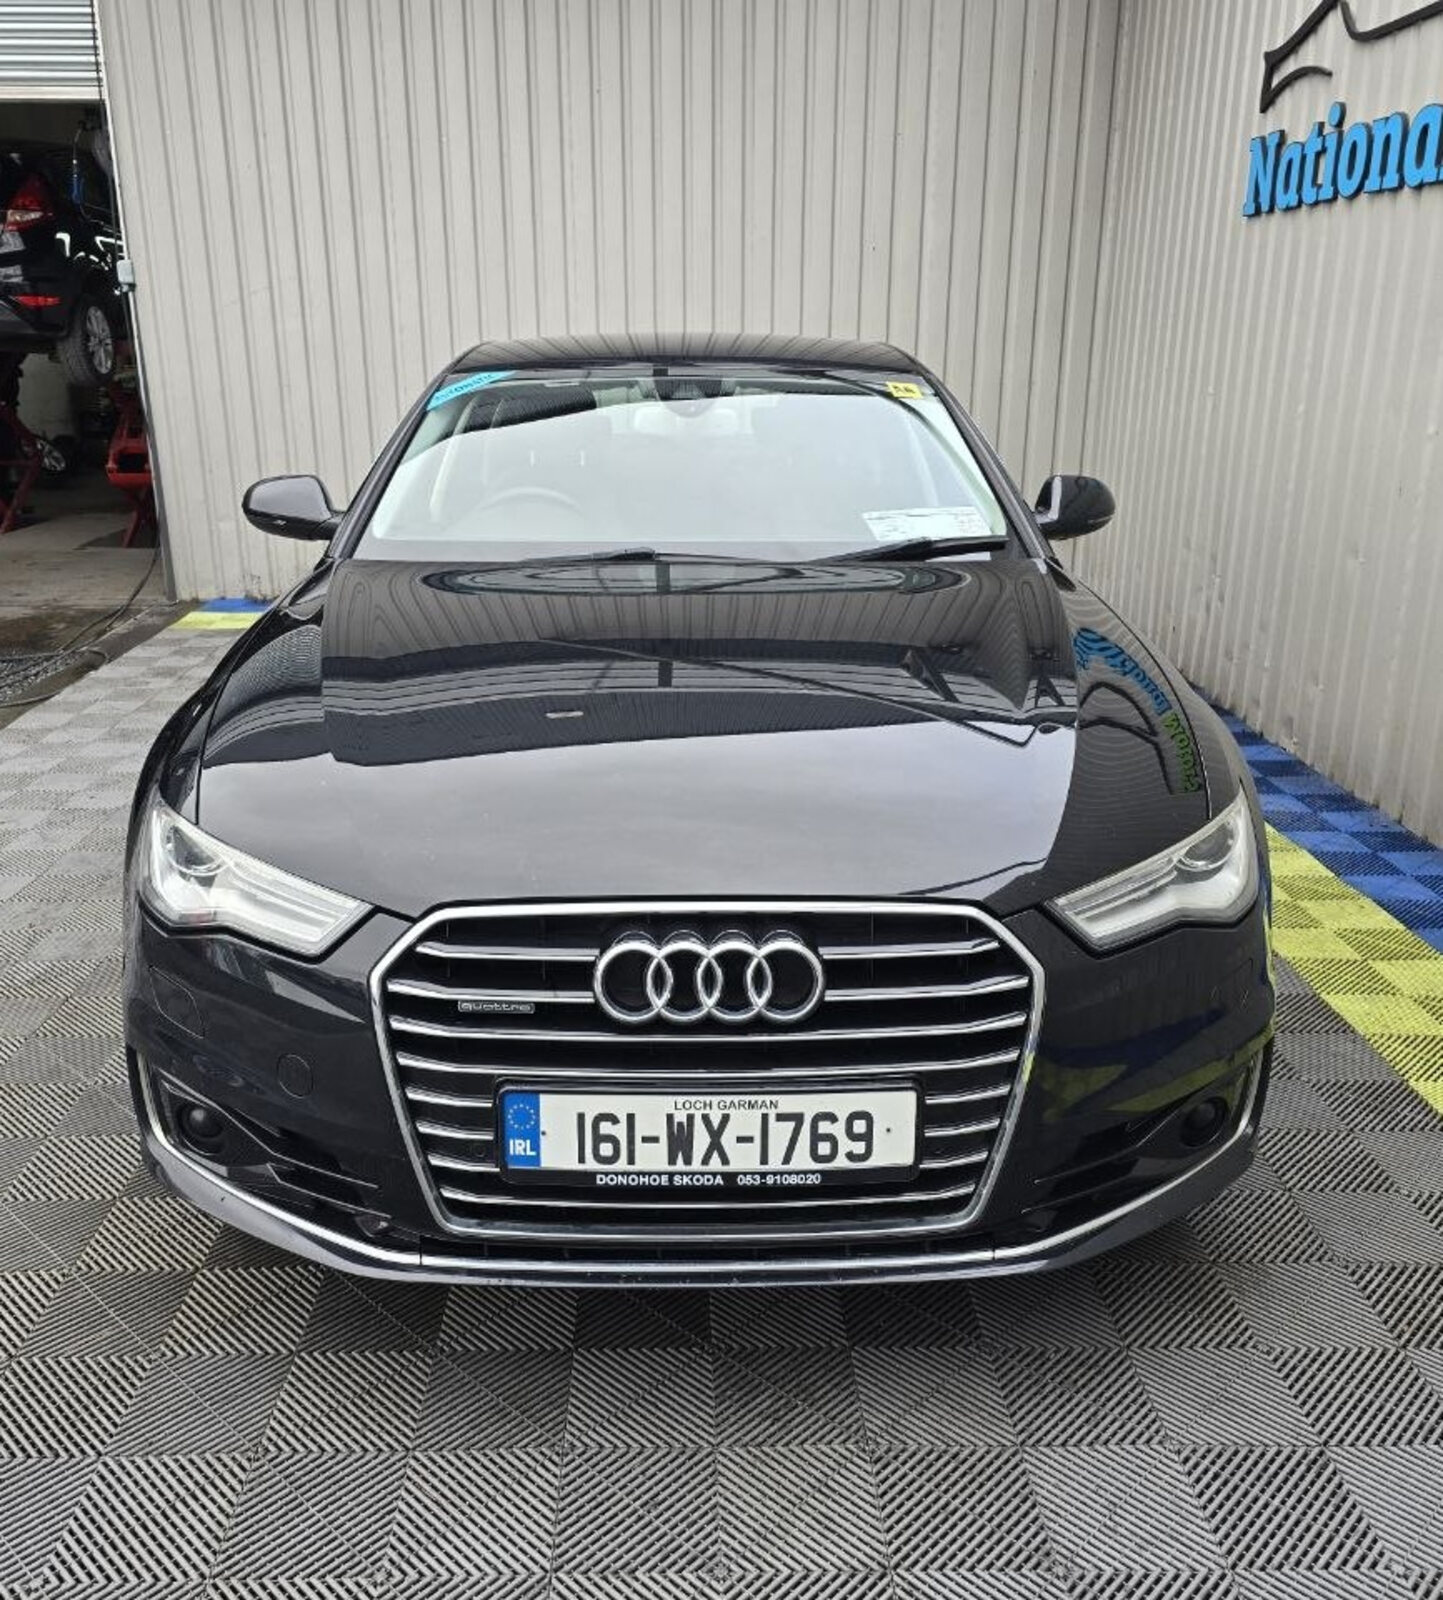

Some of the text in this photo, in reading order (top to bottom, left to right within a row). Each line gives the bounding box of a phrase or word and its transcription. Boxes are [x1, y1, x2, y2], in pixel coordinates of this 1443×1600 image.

[1242, 101, 1443, 218] Nationa
[460, 1001, 532, 1012] quattro
[674, 1099, 779, 1111] LOCH GARMAN
[577, 1110, 875, 1166] 161-WX-1769
[509, 1139, 537, 1156] IRL
[595, 1173, 821, 1186] DONOHOE SKODA 053-9108020
